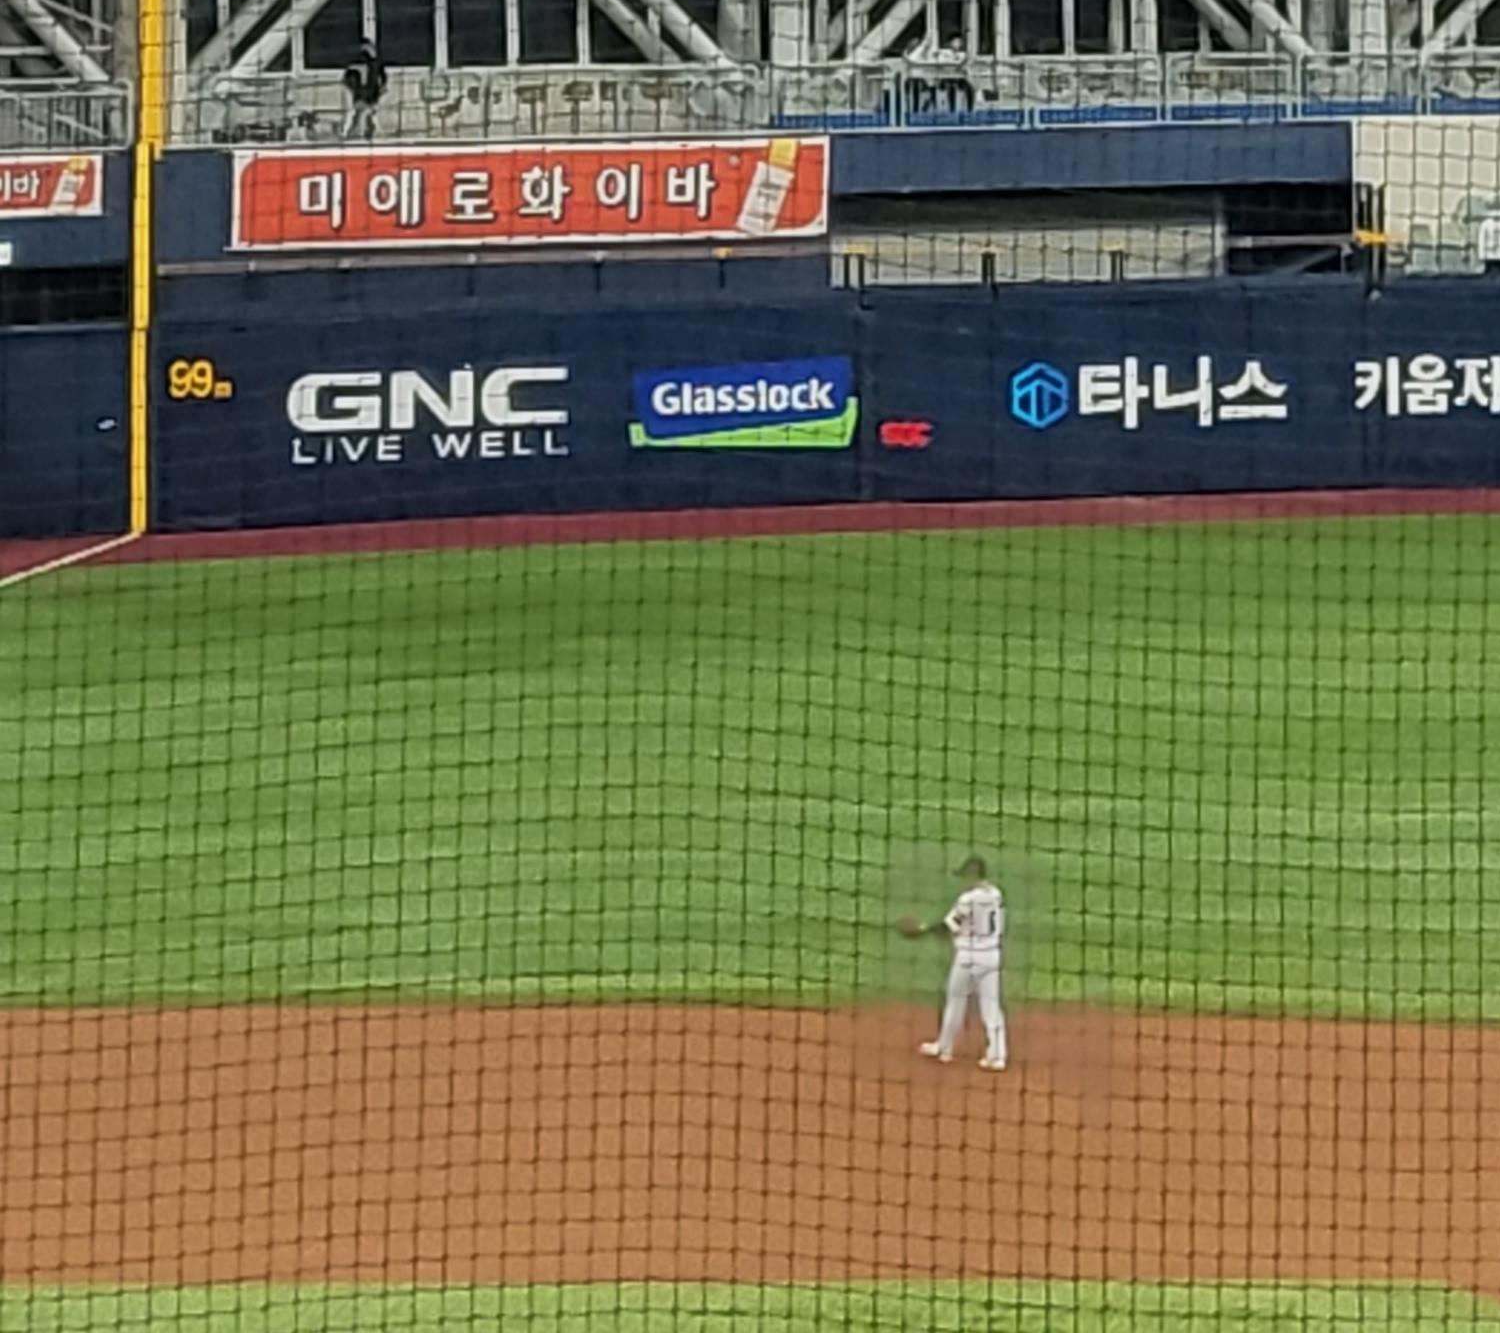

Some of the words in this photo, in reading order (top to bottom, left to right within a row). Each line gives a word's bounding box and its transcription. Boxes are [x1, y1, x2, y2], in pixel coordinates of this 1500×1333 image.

[298, 162, 718, 230] 미에로화이바
[286, 366, 569, 431] GNC
[651, 378, 834, 415] Glasslock
[1078, 356, 1288, 429] 타니스
[292, 437, 404, 464] LIVE
[432, 431, 569, 459] WELL
